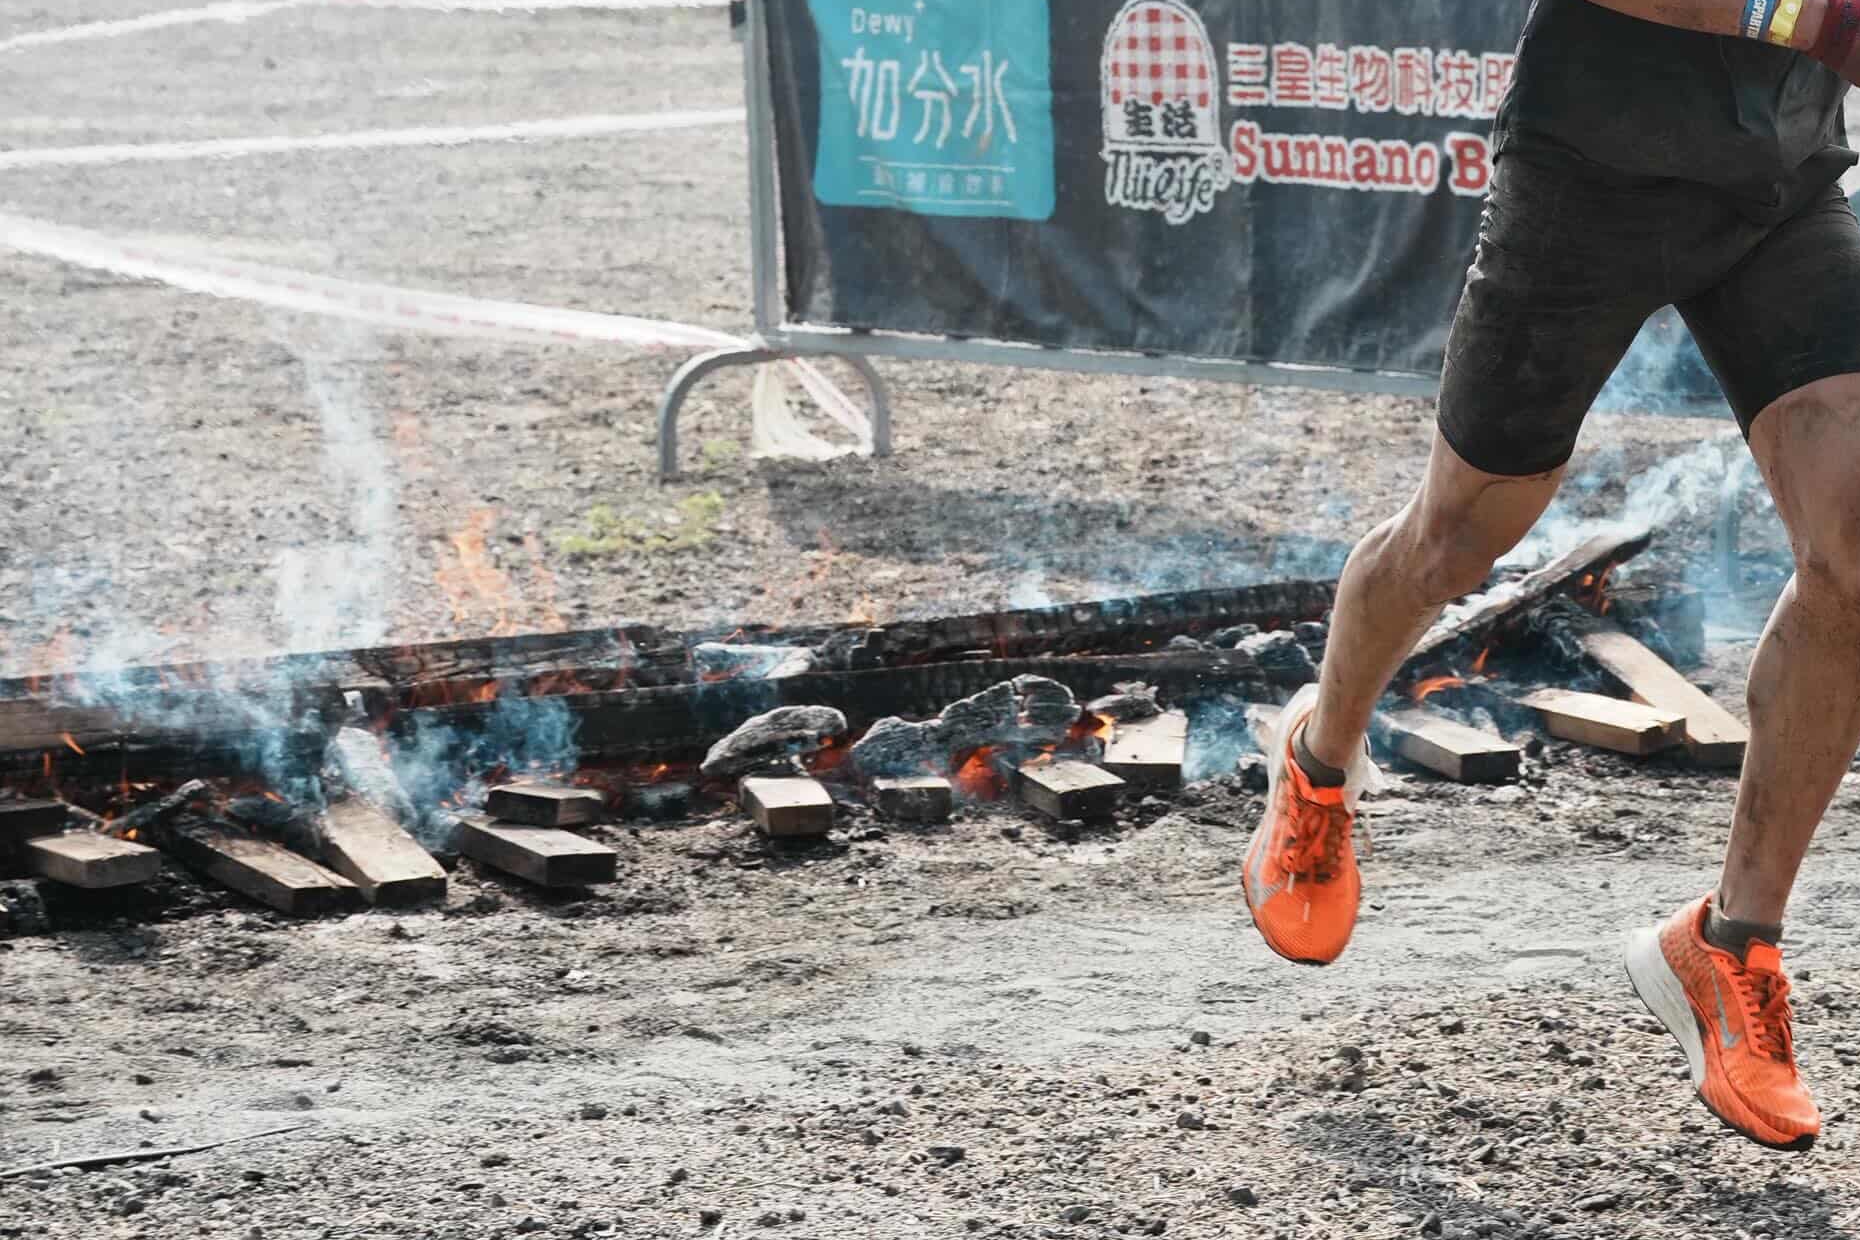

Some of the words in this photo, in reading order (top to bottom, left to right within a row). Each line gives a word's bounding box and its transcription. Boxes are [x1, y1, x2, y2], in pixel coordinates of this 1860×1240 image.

[851, 7, 915, 43] Dewy
[841, 47, 1018, 151] 加分水
[1124, 99, 1198, 139] 生活
[1232, 126, 1437, 187] Sunnano
[1452, 139, 1487, 190] B
